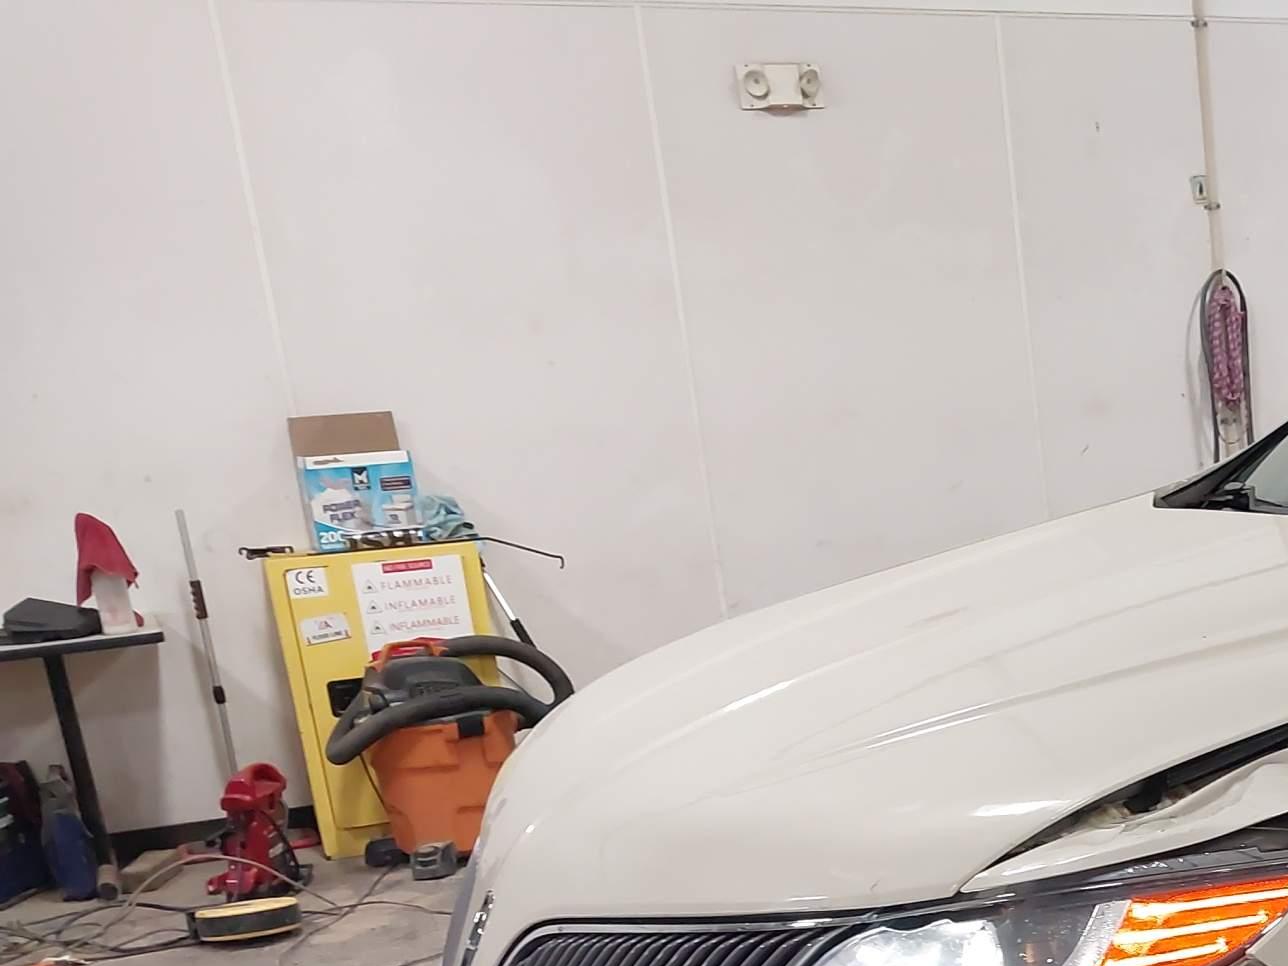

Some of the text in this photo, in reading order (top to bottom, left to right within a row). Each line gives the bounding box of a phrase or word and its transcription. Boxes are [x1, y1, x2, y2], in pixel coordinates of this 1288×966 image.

[295, 570, 316, 585] CE
[380, 575, 453, 590] FLAMMABLE
[294, 585, 325, 596] OSHA
[384, 595, 456, 610] INFLAMABLE
[390, 615, 461, 631] INFLAMMABLE
